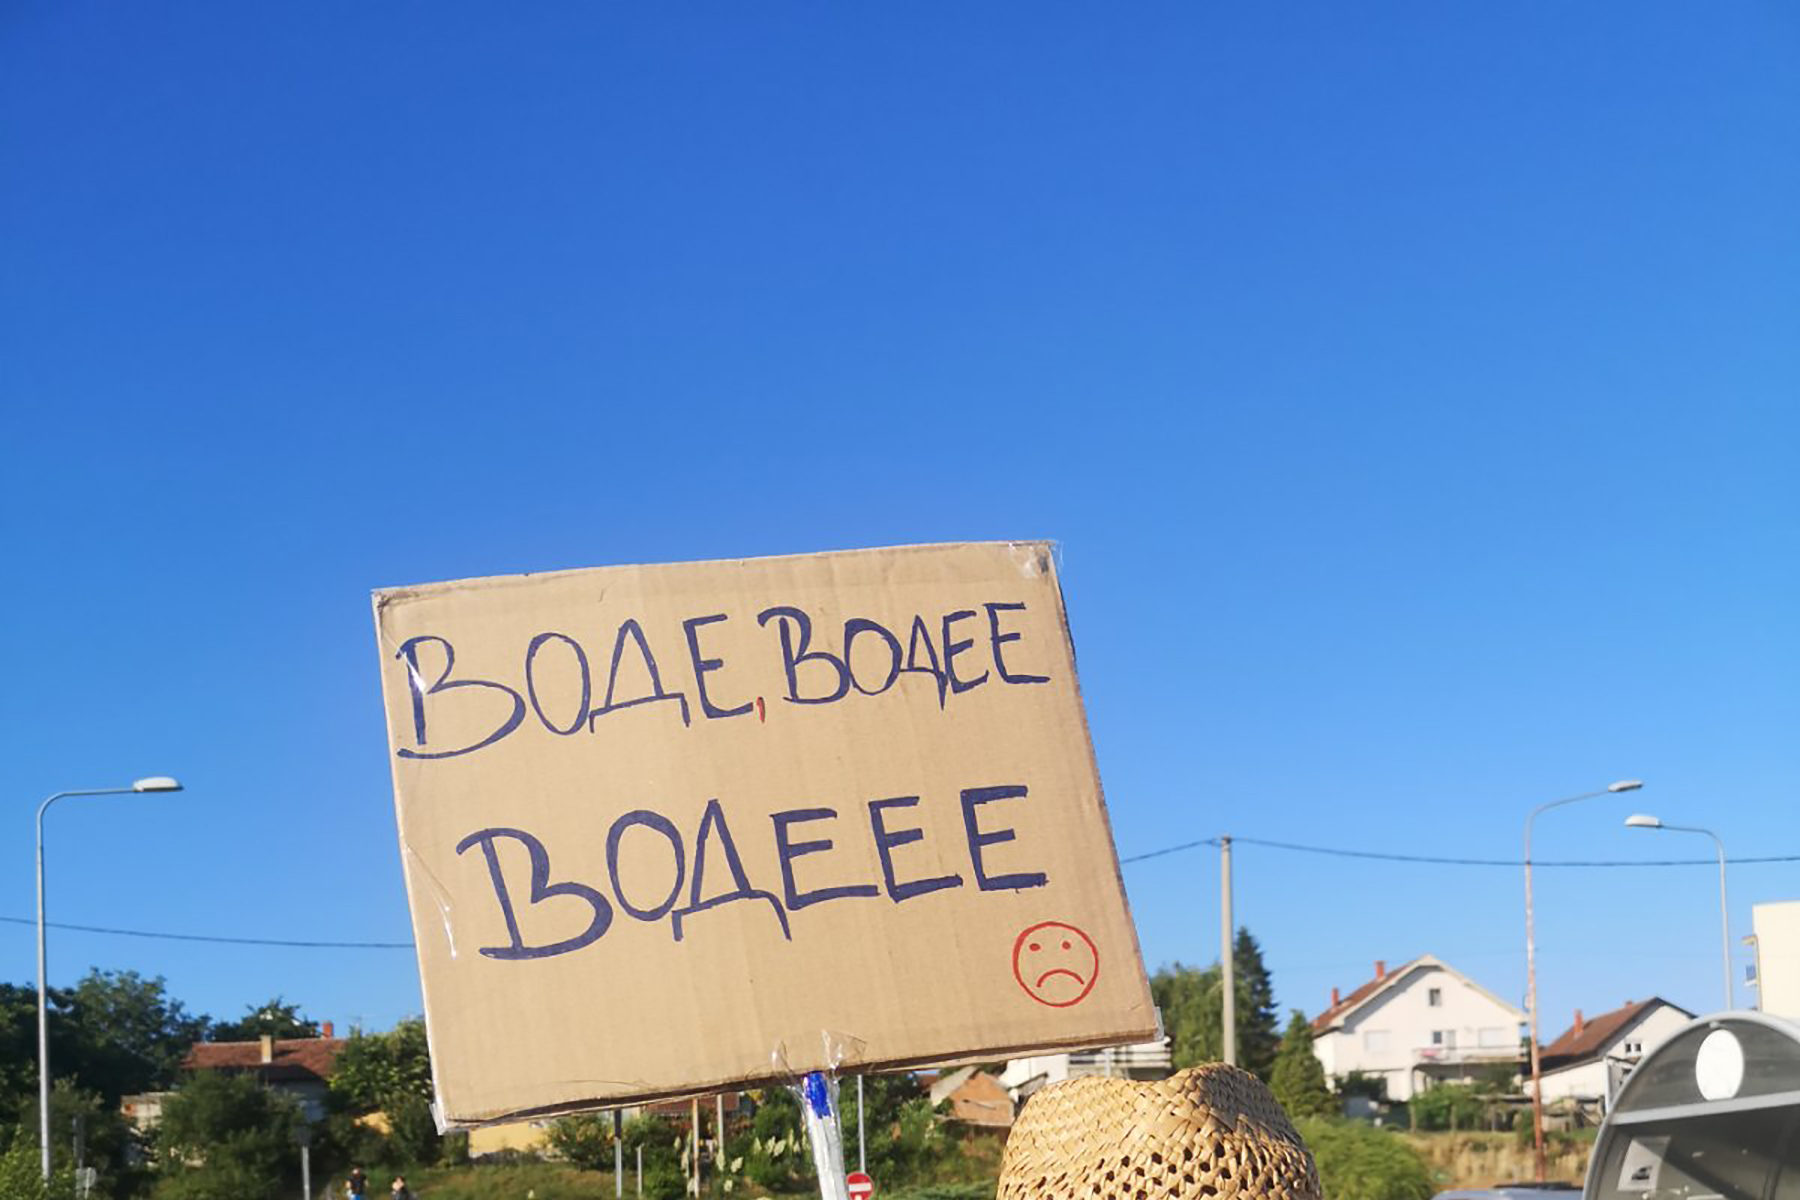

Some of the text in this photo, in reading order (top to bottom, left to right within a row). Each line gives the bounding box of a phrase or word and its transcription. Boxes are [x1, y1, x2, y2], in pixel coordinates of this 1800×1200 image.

[395, 602, 1051, 760] ВОДЕ, ВОДЕЕ
[456, 785, 1048, 961] ВОДЕЕЕ
